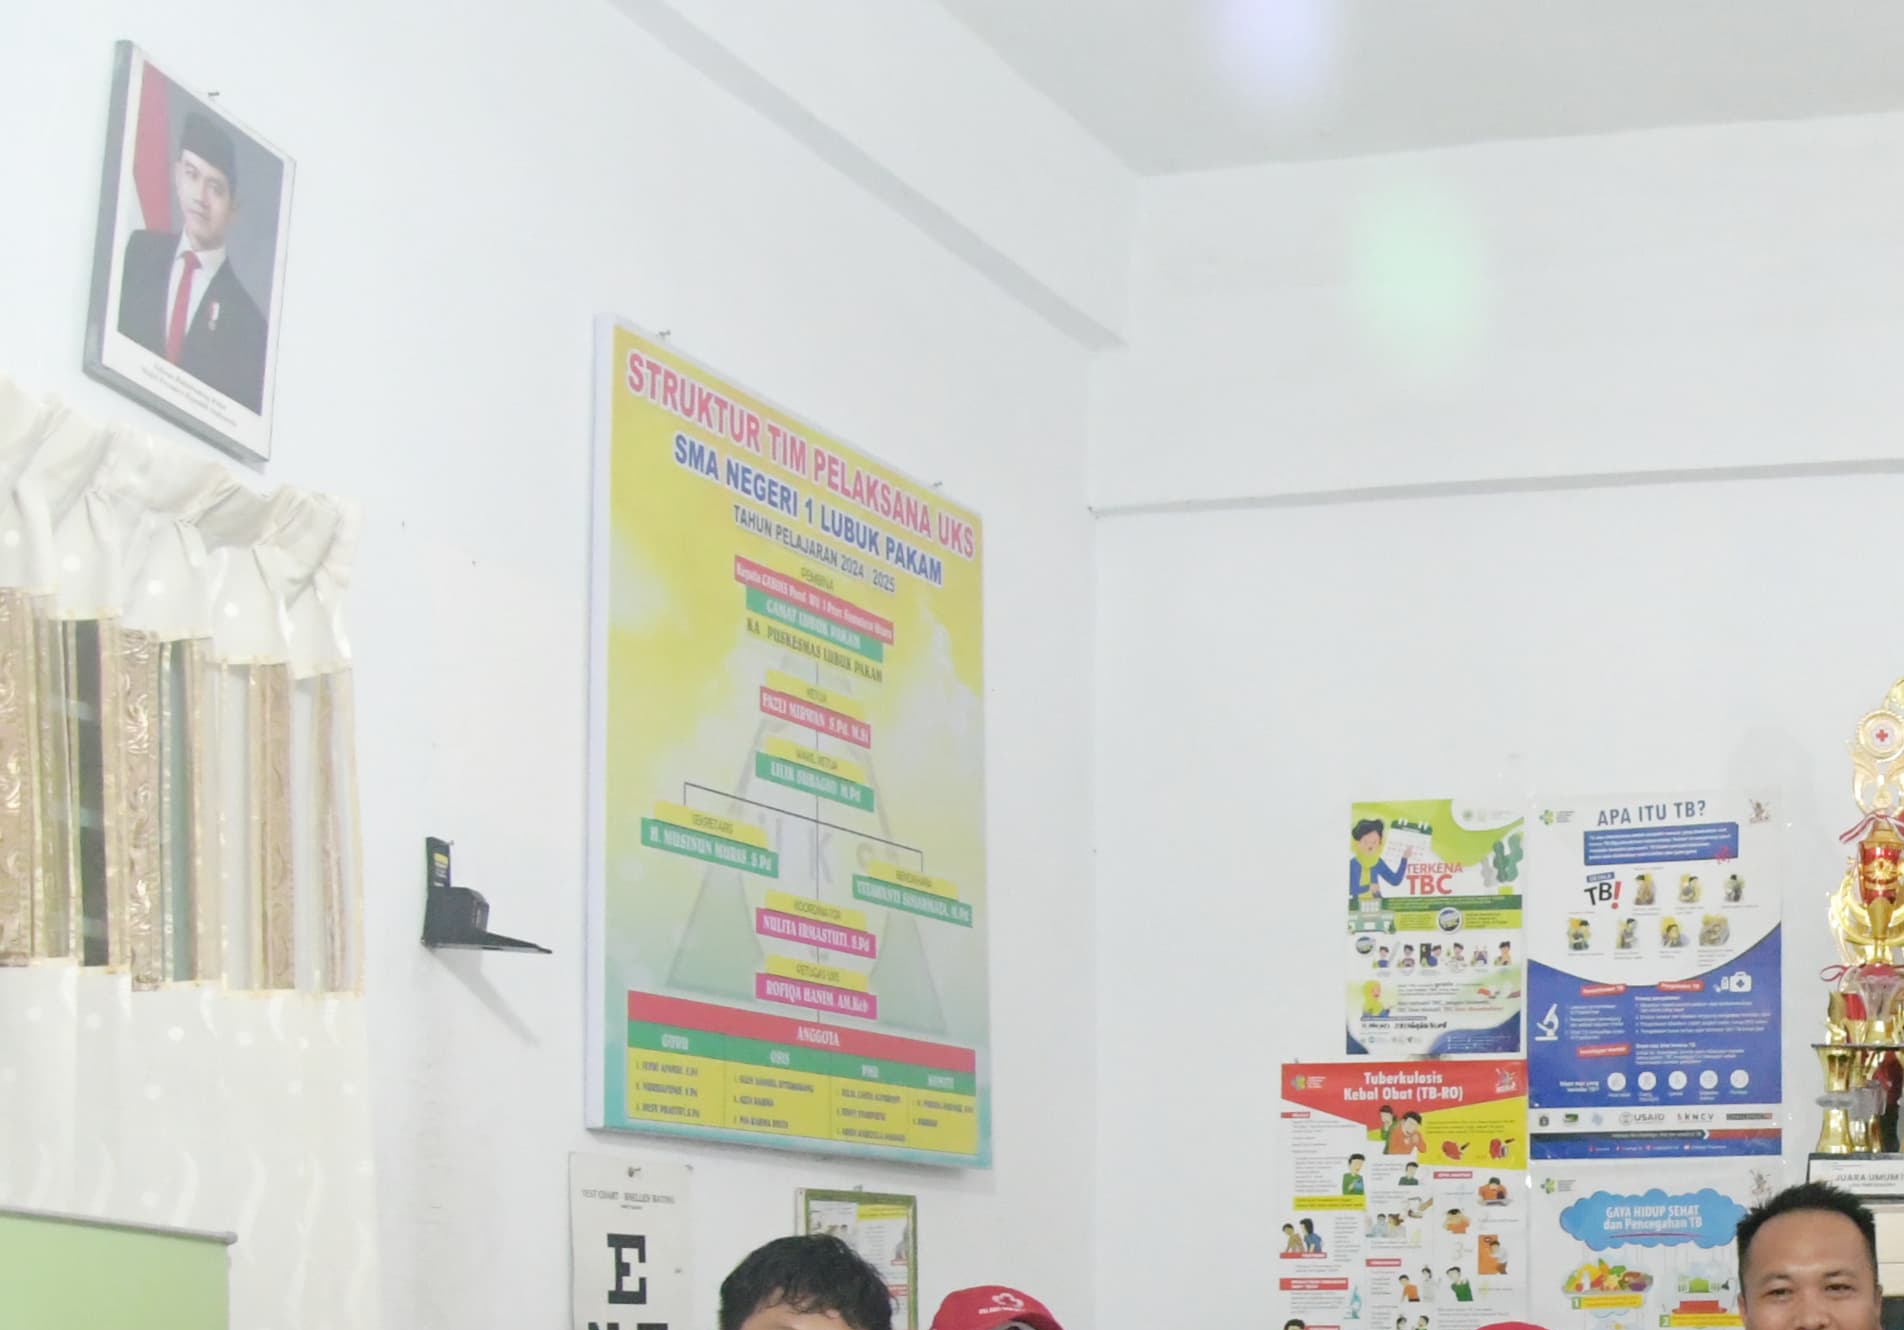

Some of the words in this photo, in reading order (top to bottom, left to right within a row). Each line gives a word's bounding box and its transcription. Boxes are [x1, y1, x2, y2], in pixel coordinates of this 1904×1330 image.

[627, 353, 760, 452] STRUKTUR
[768, 424, 807, 477] TIM
[814, 448, 931, 539] PELAKSANA
[938, 515, 975, 560] UKS
[674, 434, 719, 481] SMA
[726, 459, 798, 514] NEGERI
[804, 497, 814, 524] 1
[820, 505, 880, 553] LUBUK
[885, 537, 942, 585] PAKAM
[734, 505, 772, 539] TAHUN
[775, 519, 838, 568] PELAJARAN
[841, 554, 865, 579] 2024
[872, 569, 896, 592] 2025
[1598, 809, 1631, 826] APA
[1638, 804, 1667, 822] ITU
[1674, 800, 1706, 818] TB?
[1407, 862, 1463, 874] TERKENA
[1406, 874, 1453, 896] TBC
[1584, 881, 1622, 909] TB!
[797, 1027, 839, 1047] ANGGOTA
[1364, 1072, 1443, 1085] Tuberkulosis
[1344, 1088, 1379, 1100] Kebal
[1383, 1087, 1412, 1100] Obat
[1416, 1086, 1464, 1102] (TB-RO)
[1836, 1174, 1866, 1182] JUARA
[1606, 1206, 1631, 1218] GAYA
[1634, 1205, 1665, 1218] HIDUP
[1667, 1205, 1700, 1217] SEHAT
[1604, 1219, 1622, 1231] dan
[1625, 1218, 1686, 1232] Pencegahan
[1690, 1218, 1702, 1229] TB
[607, 1233, 647, 1304] E
